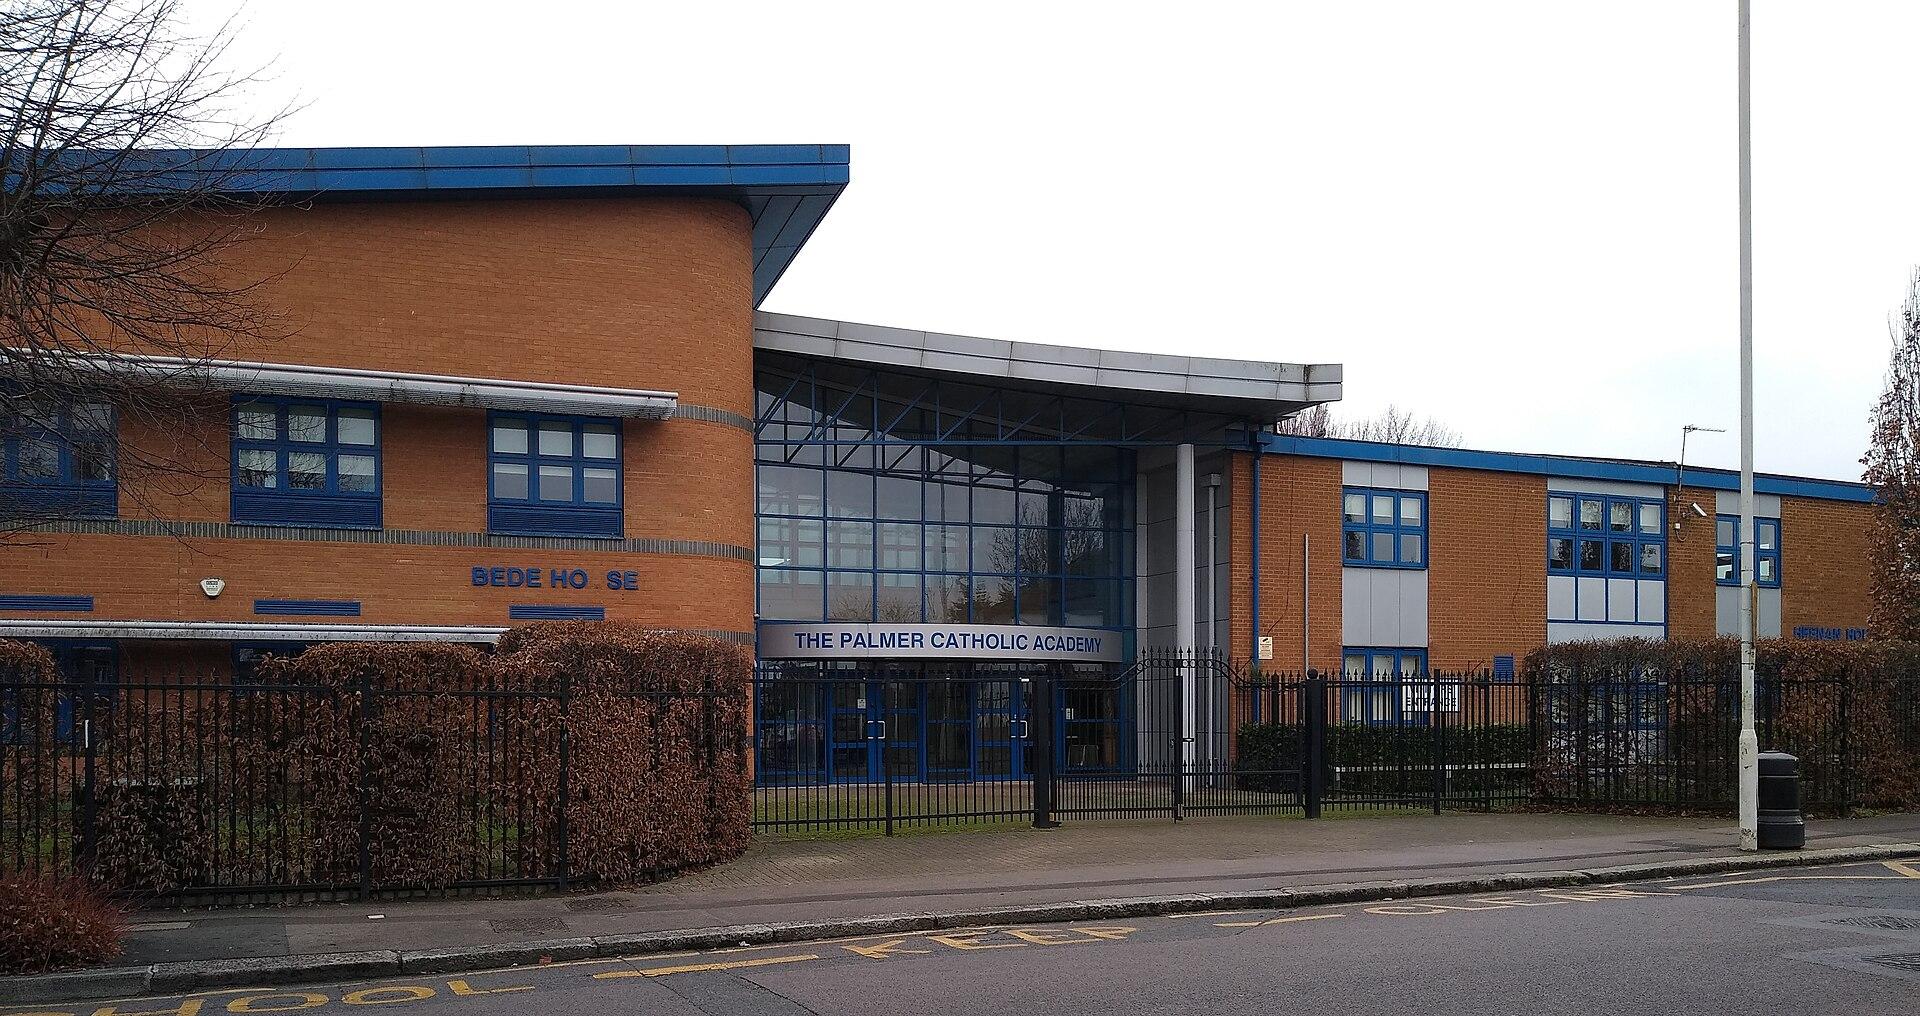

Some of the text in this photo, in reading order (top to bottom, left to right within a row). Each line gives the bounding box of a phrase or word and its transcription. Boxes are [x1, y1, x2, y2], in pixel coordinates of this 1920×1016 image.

[472, 566, 541, 587] BEDE
[795, 632, 1102, 653] THE PALMER CATHOLIC ACADEMY
[0, 889, 1682, 1016] HOOL KEEP CLEAR
